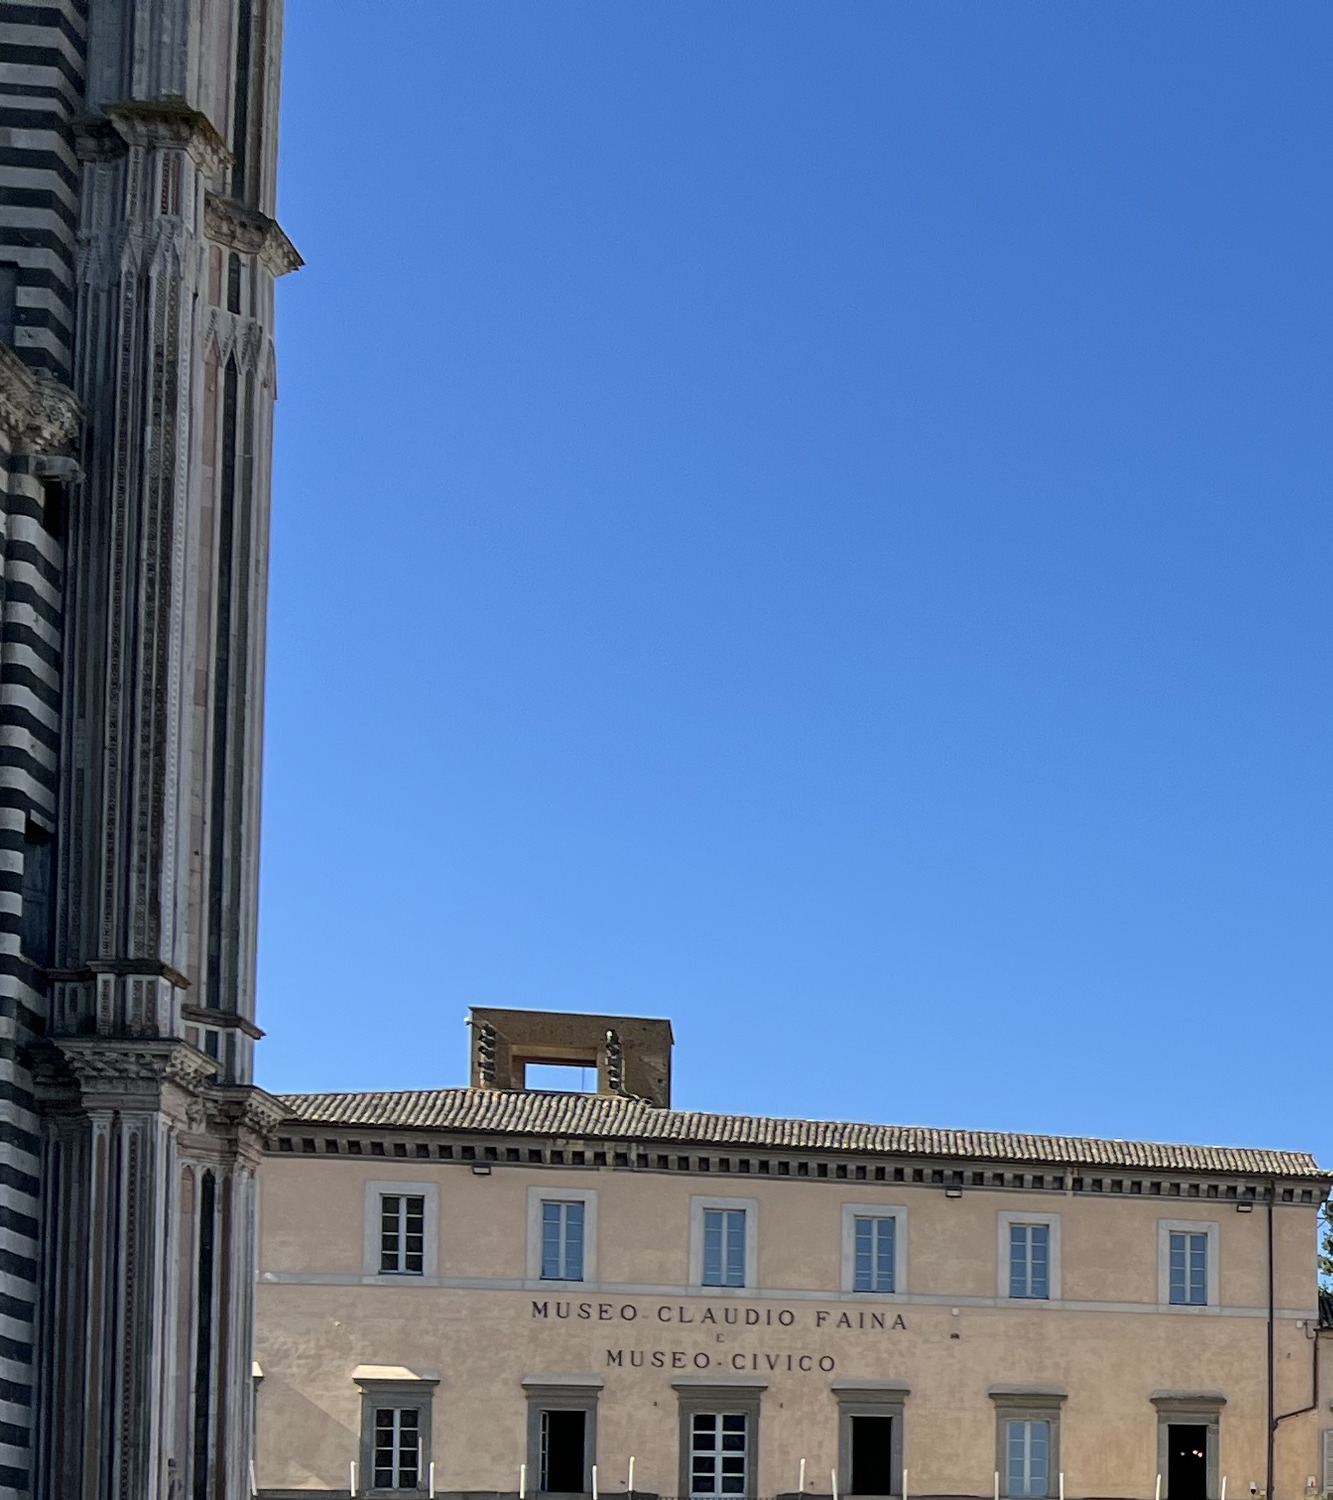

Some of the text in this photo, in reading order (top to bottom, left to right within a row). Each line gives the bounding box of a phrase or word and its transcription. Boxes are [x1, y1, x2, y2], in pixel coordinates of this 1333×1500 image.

[532, 1301, 907, 1330] MUSEO CLAUDIO FAINA
[716, 1333, 725, 1343] E
[606, 1350, 835, 1372] MUSEO CIVICO
